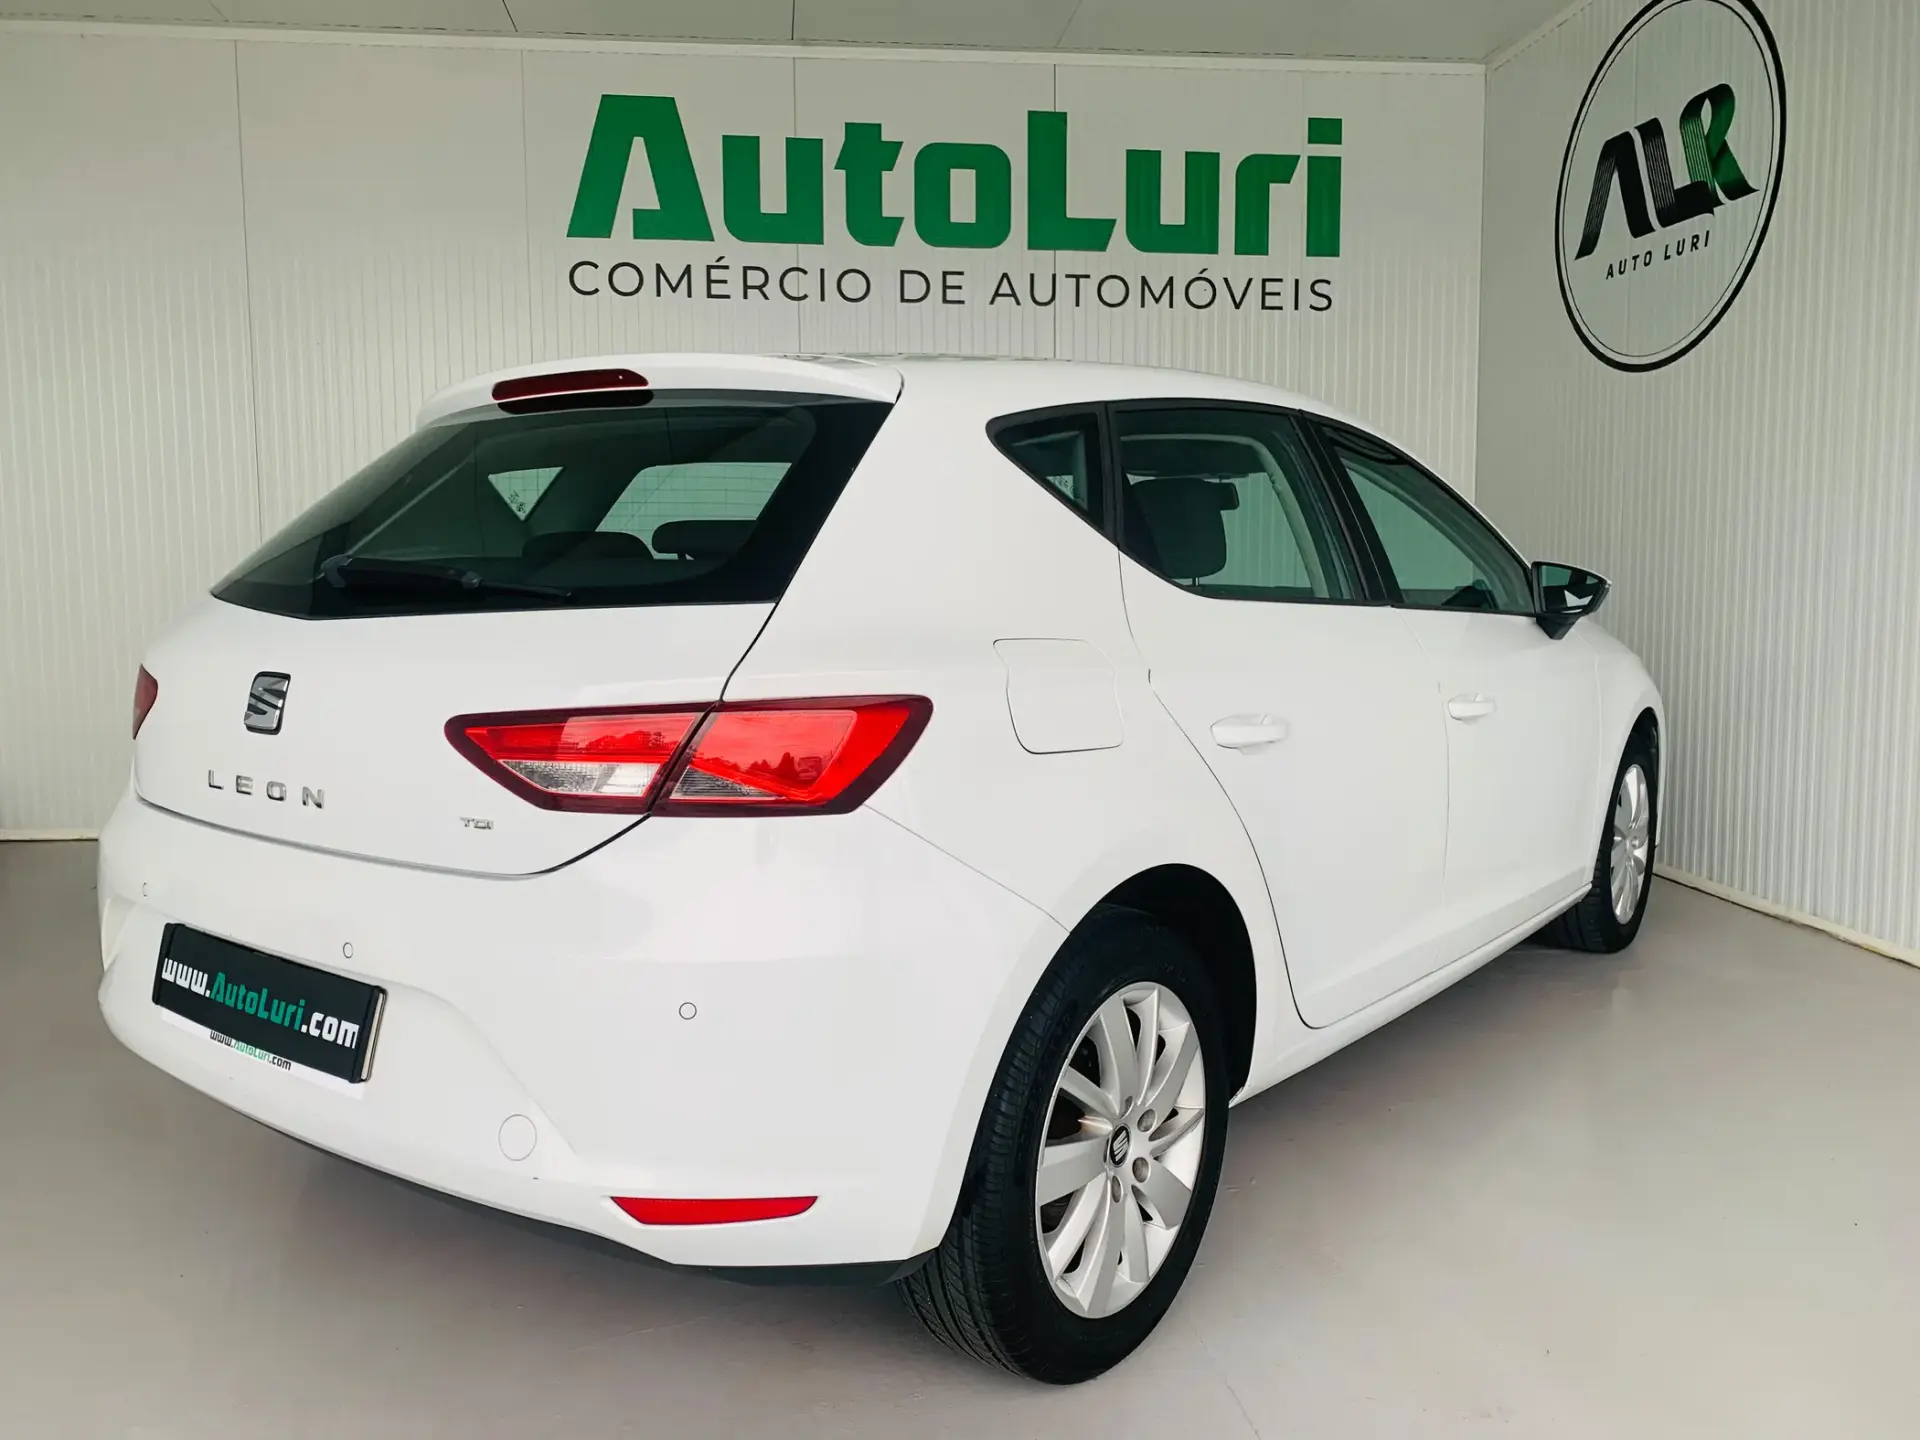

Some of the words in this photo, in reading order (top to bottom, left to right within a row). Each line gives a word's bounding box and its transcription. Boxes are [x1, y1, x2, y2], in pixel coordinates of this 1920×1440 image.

[566, 93, 1343, 257] AutoLuri
[1605, 250, 1653, 281] AUTO
[1663, 230, 1711, 261] LURI
[568, 255, 871, 304] COMÉRCIO
[899, 268, 966, 305] DE
[989, 268, 1333, 312] AUTOMÓVEIS
[208, 769, 325, 810] LEON
[460, 816, 495, 831] TDI
[161, 957, 360, 1050] www.AutoLuri.com
